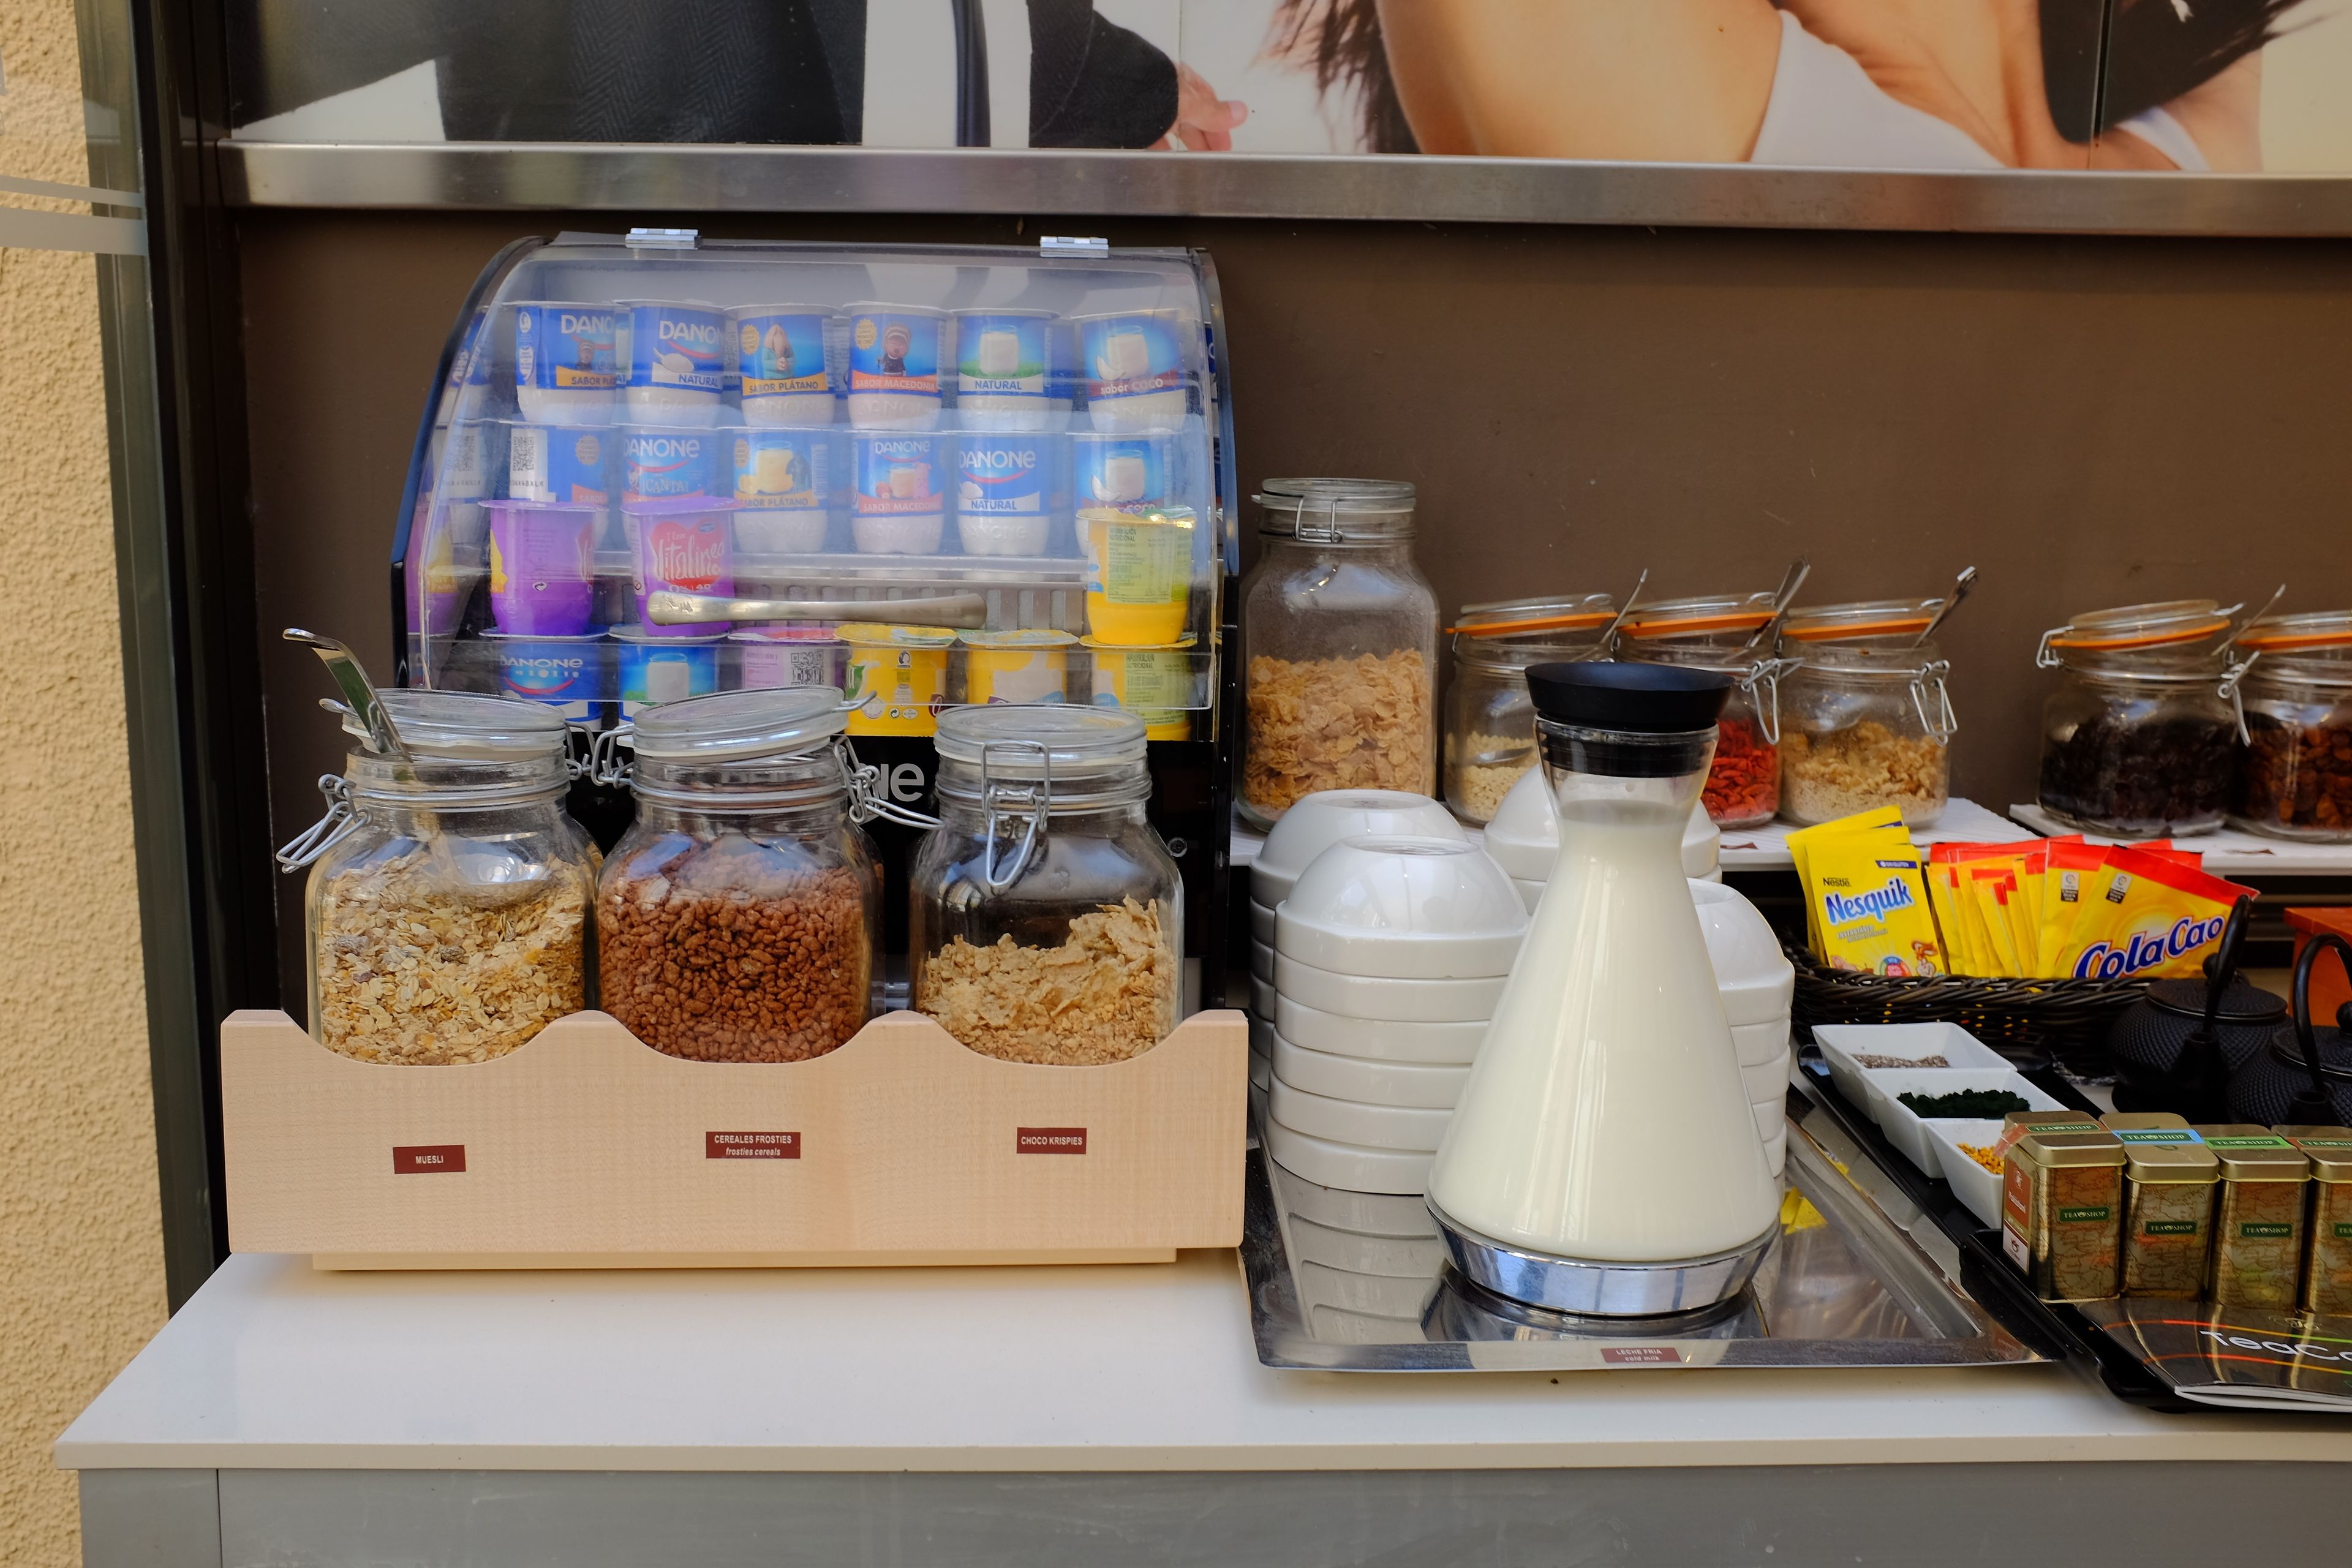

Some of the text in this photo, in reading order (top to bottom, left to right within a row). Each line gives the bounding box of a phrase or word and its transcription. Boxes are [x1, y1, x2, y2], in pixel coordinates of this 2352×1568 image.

[560, 314, 615, 334] DANO
[571, 377, 601, 385] SABOR
[679, 374, 718, 387] NATURAL
[855, 379, 936, 391] SABOR MACEDONIA
[975, 380, 1022, 390] NATURAL
[749, 380, 819, 393] SABOR PLÁTANO
[1101, 378, 1164, 394] sabor coco
[768, 496, 809, 507] PLÁTANO
[971, 500, 1017, 510] NATURAL
[864, 503, 891, 512] SABOR
[647, 535, 725, 582] Vitalinea
[1825, 877, 1913, 924] Nesquik
[714, 1135, 792, 1144] CEREALES FROSTIES
[1021, 1136, 1083, 1145] CHOCO KRISPIES
[726, 1147, 753, 1156] frosties
[415, 1155, 444, 1164] MUESLI
